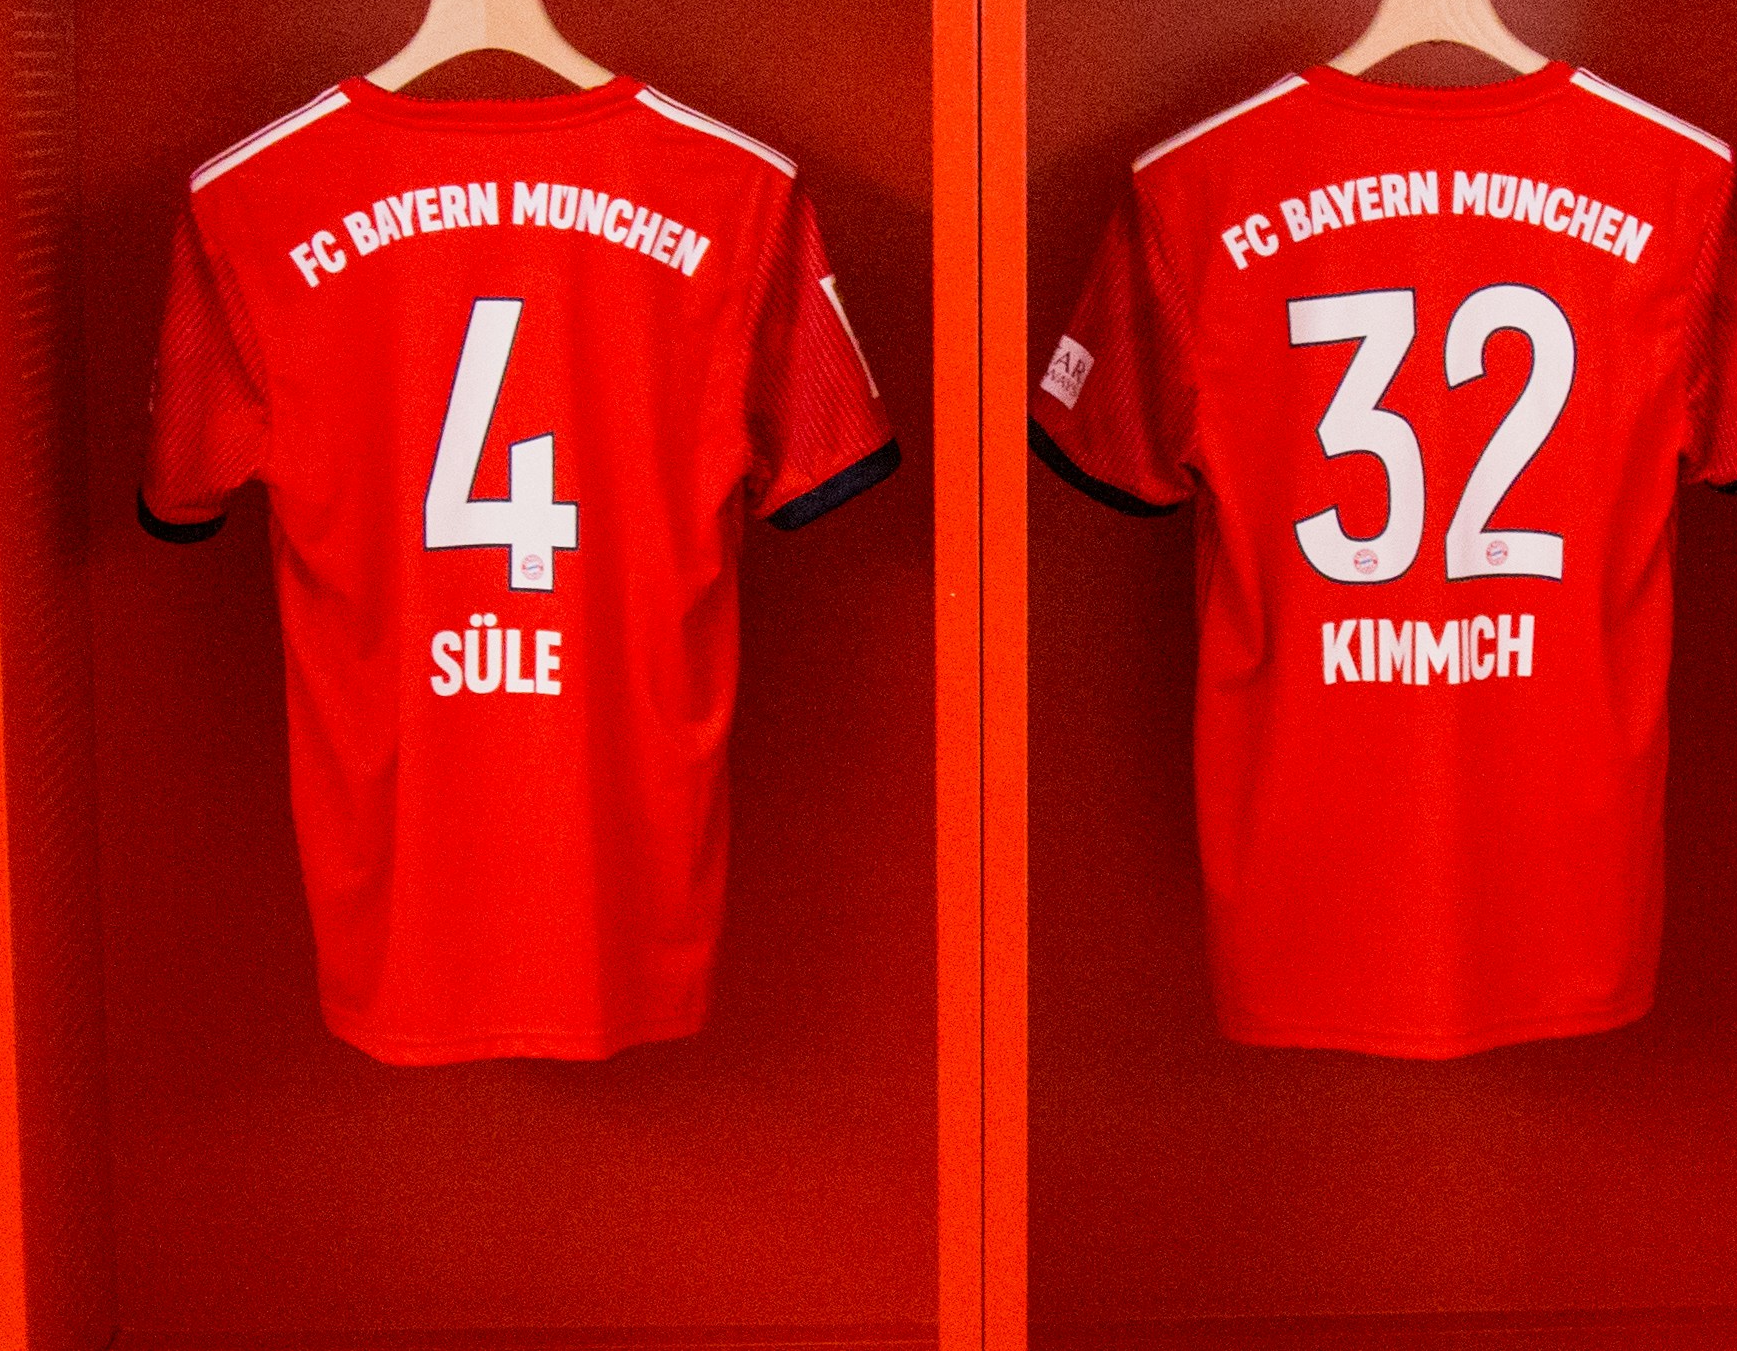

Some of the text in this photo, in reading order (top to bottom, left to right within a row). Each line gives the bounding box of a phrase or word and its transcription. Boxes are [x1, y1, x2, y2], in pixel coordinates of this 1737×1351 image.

[290, 231, 346, 287] FC
[343, 182, 499, 255] BAYERN
[1222, 214, 1278, 269] FC
[1280, 171, 1438, 239] BAYERN
[424, 298, 578, 592] 4
[1287, 283, 1576, 584] 32
[431, 613, 561, 696] SÜLE
